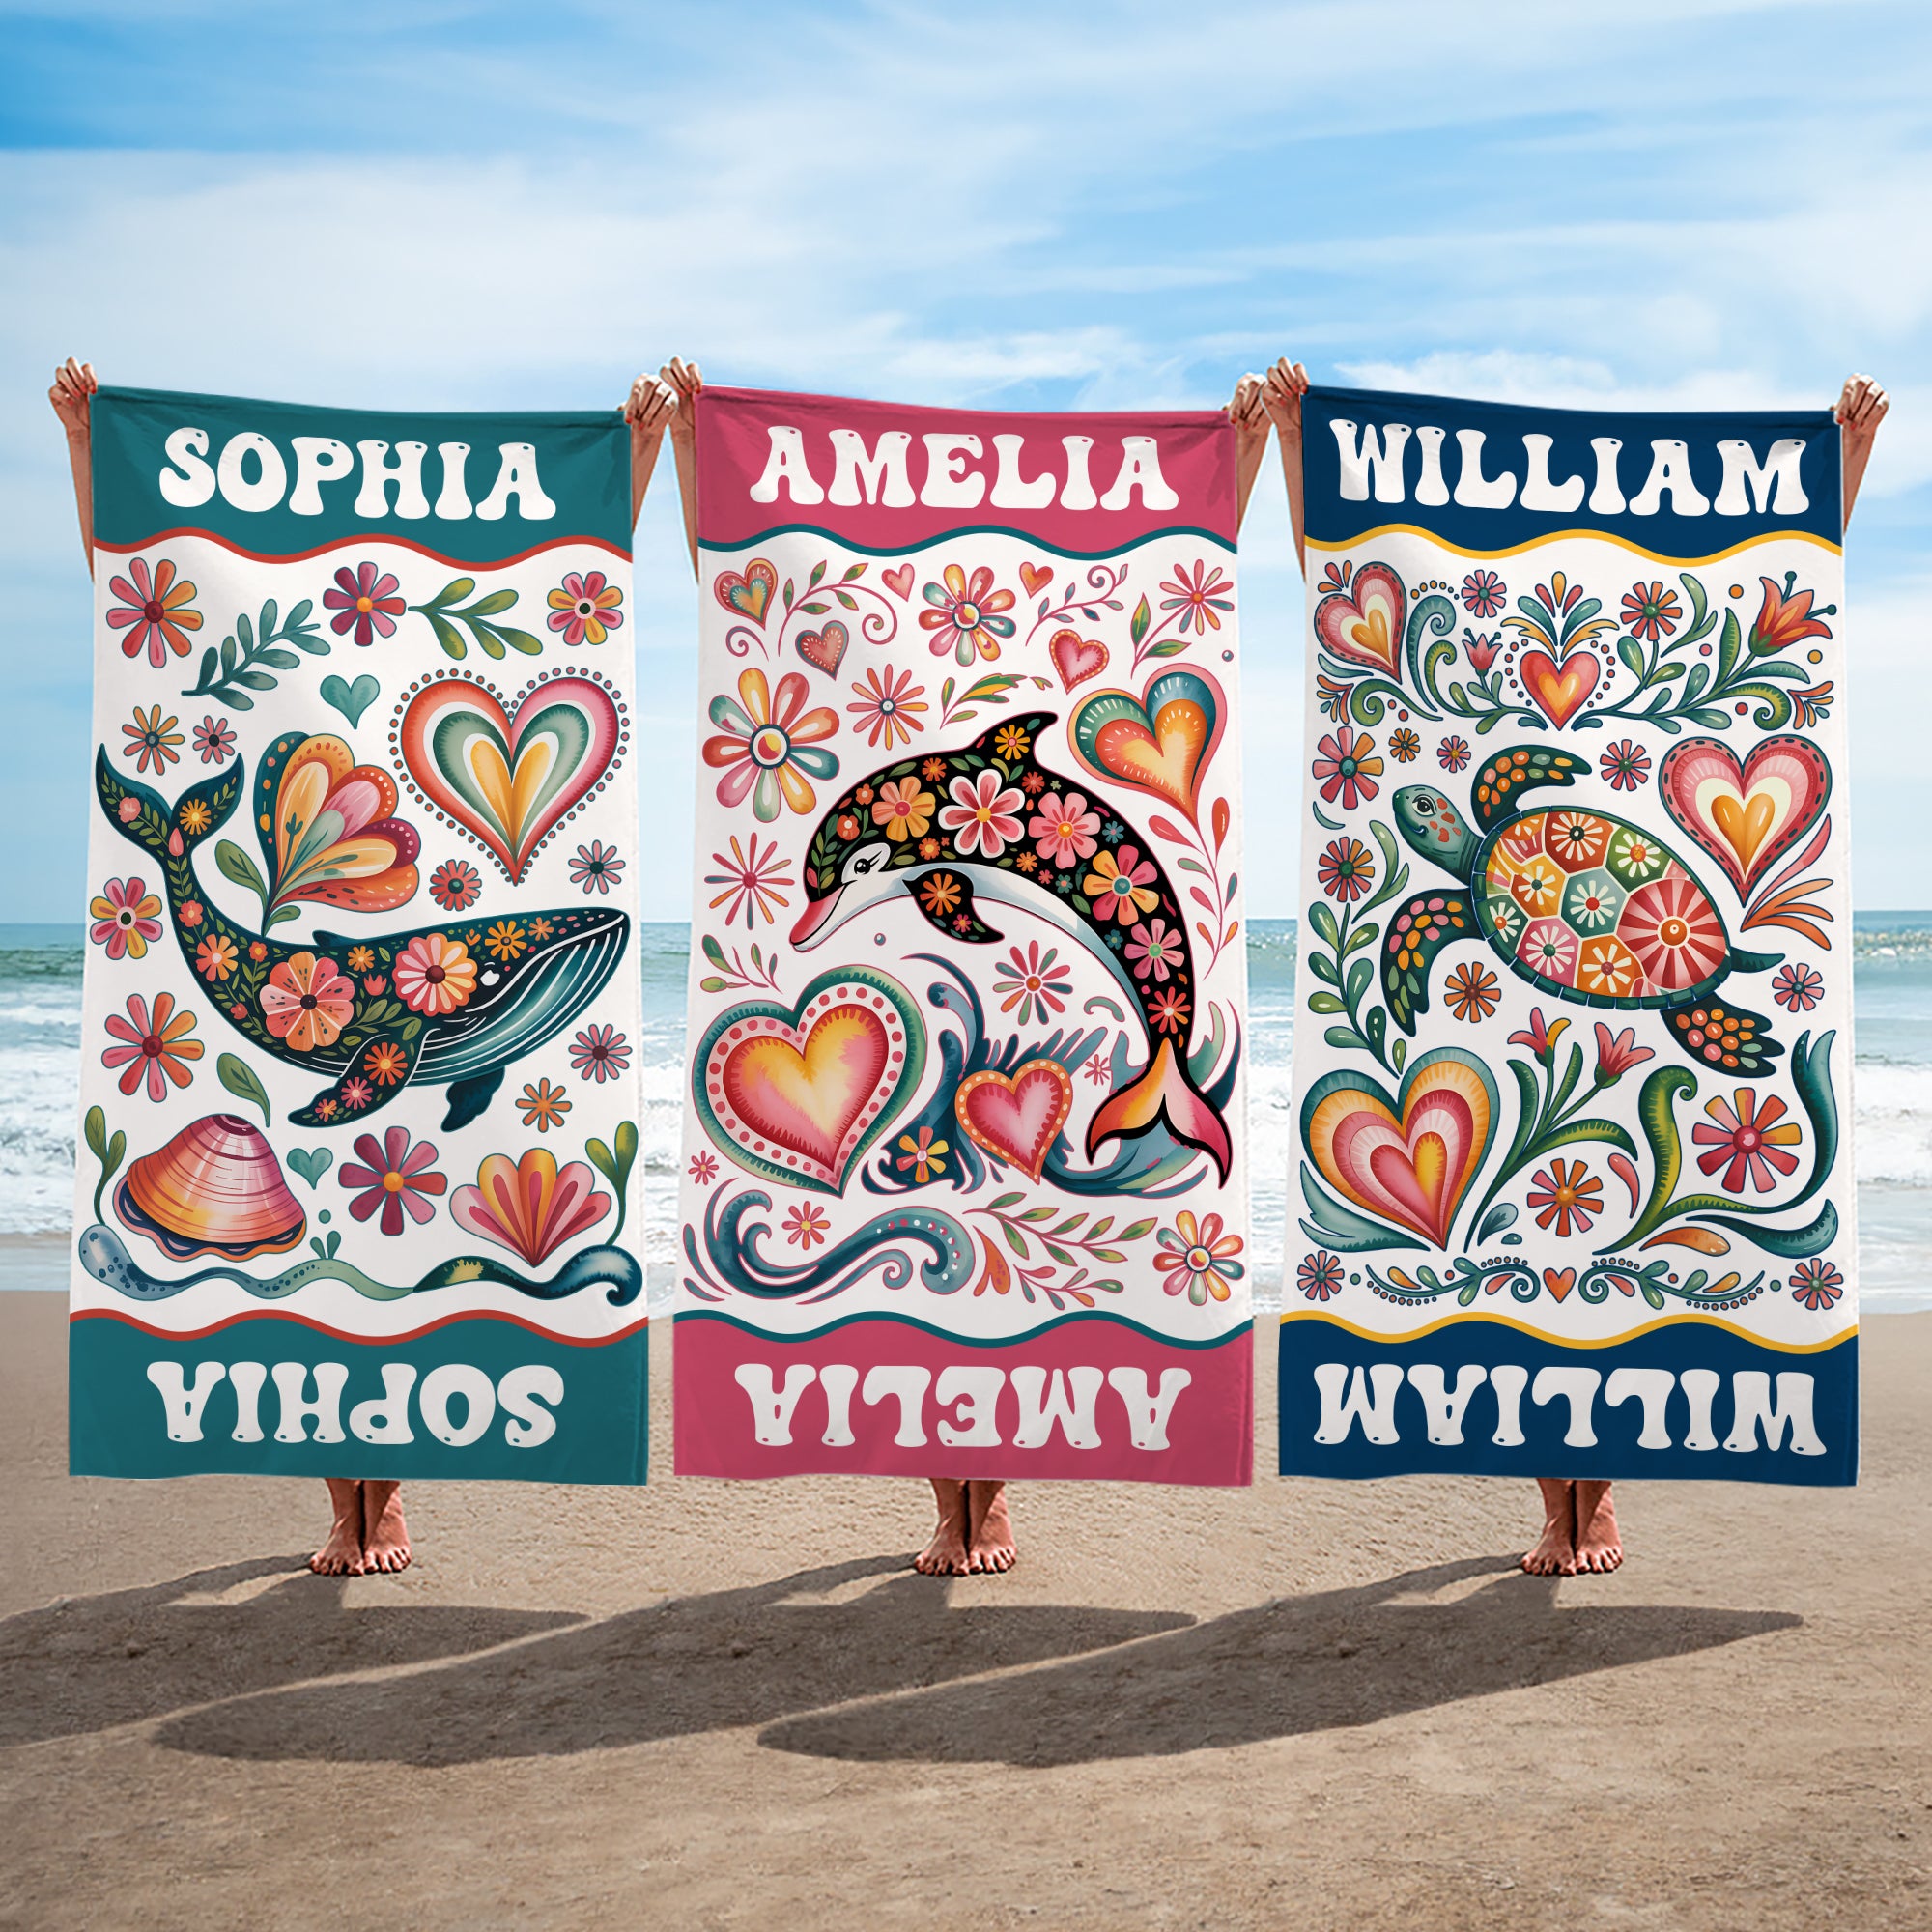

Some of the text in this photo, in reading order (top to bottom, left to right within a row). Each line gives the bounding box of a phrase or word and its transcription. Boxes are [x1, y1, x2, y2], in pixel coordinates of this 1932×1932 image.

[159, 428, 555, 520] SOPHIA
[750, 426, 1179, 510] AMELIA
[1330, 419, 1808, 516] WILLIAM
[147, 1362, 563, 1447] SOPHIA
[735, 1364, 1191, 1450] AMELIA
[1314, 1364, 1826, 1455] WILLIAM
